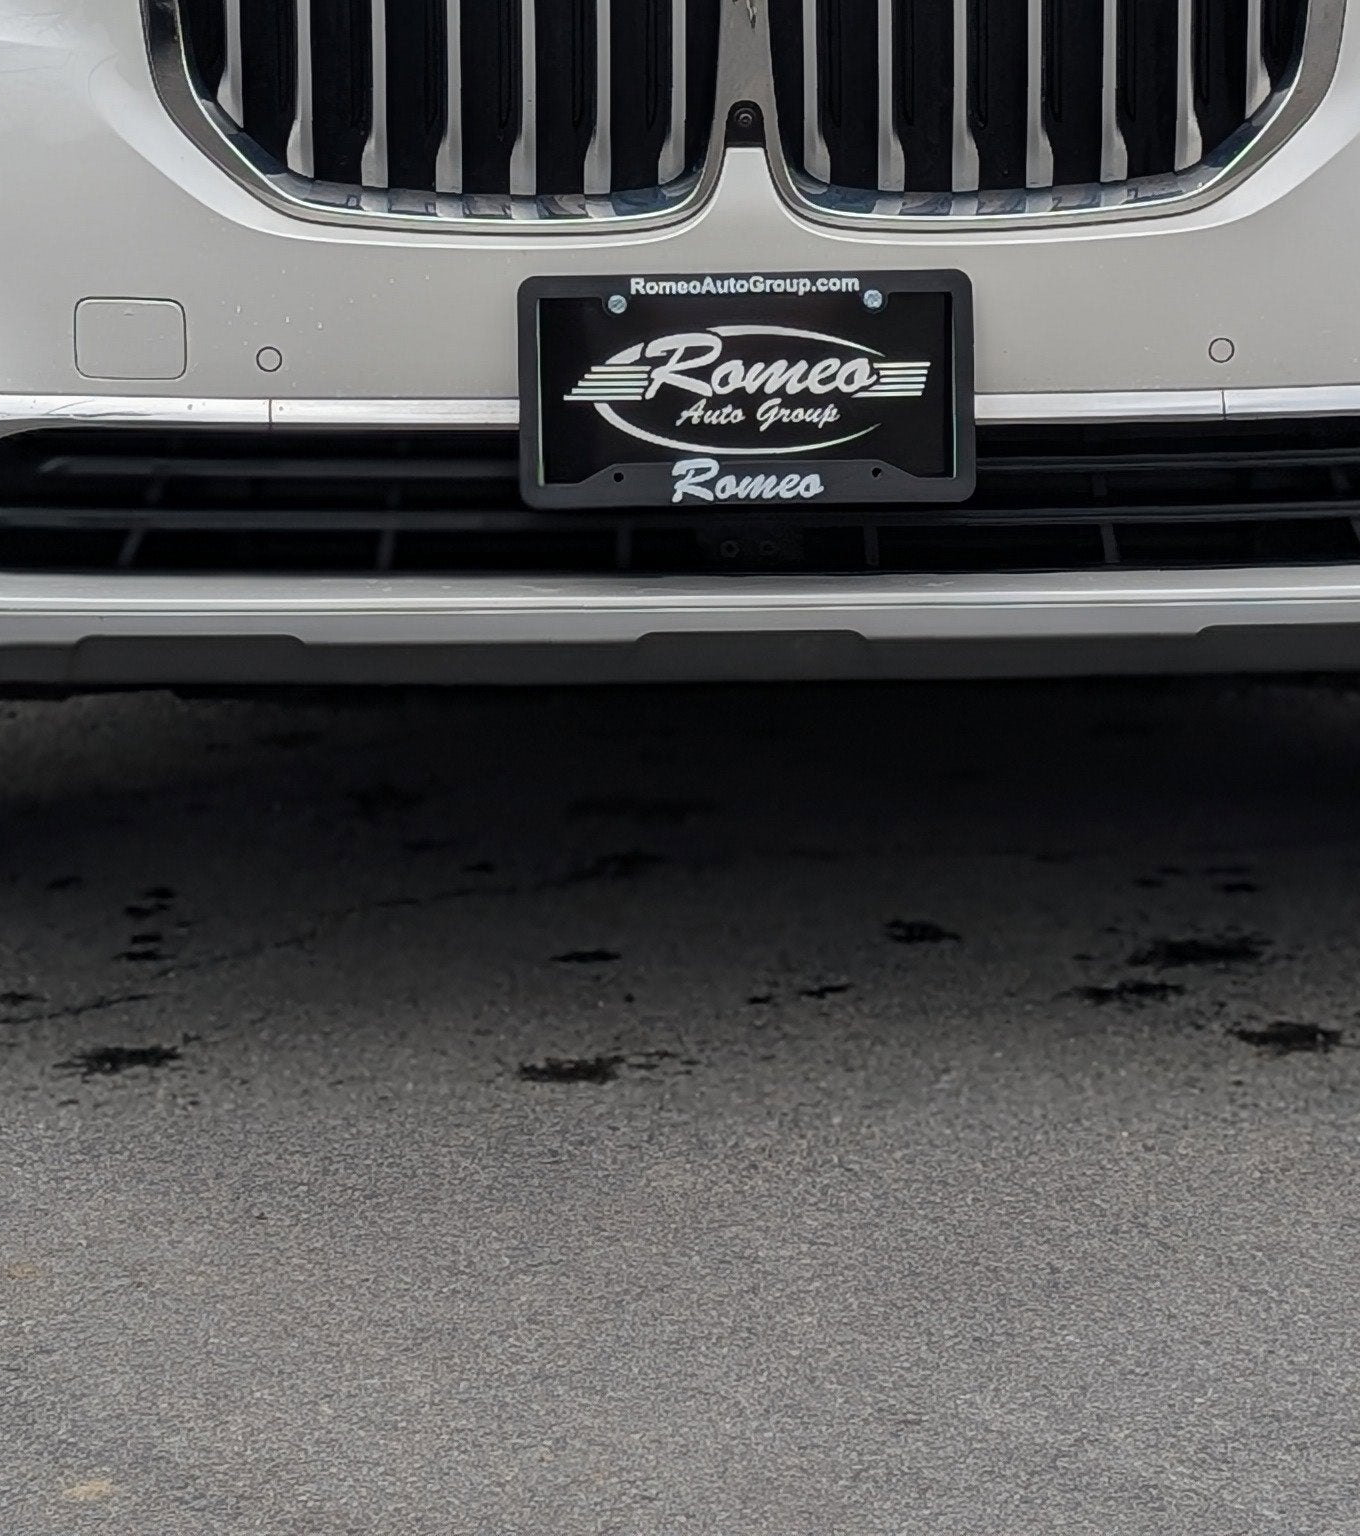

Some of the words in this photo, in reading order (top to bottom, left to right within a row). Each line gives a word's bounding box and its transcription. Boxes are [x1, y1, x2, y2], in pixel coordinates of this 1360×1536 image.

[630, 276, 860, 296] RomeoAutoGroup.com
[644, 332, 880, 400] Romeo
[676, 398, 746, 427] Auto
[755, 397, 842, 433] Group
[671, 457, 825, 504] Romeo
